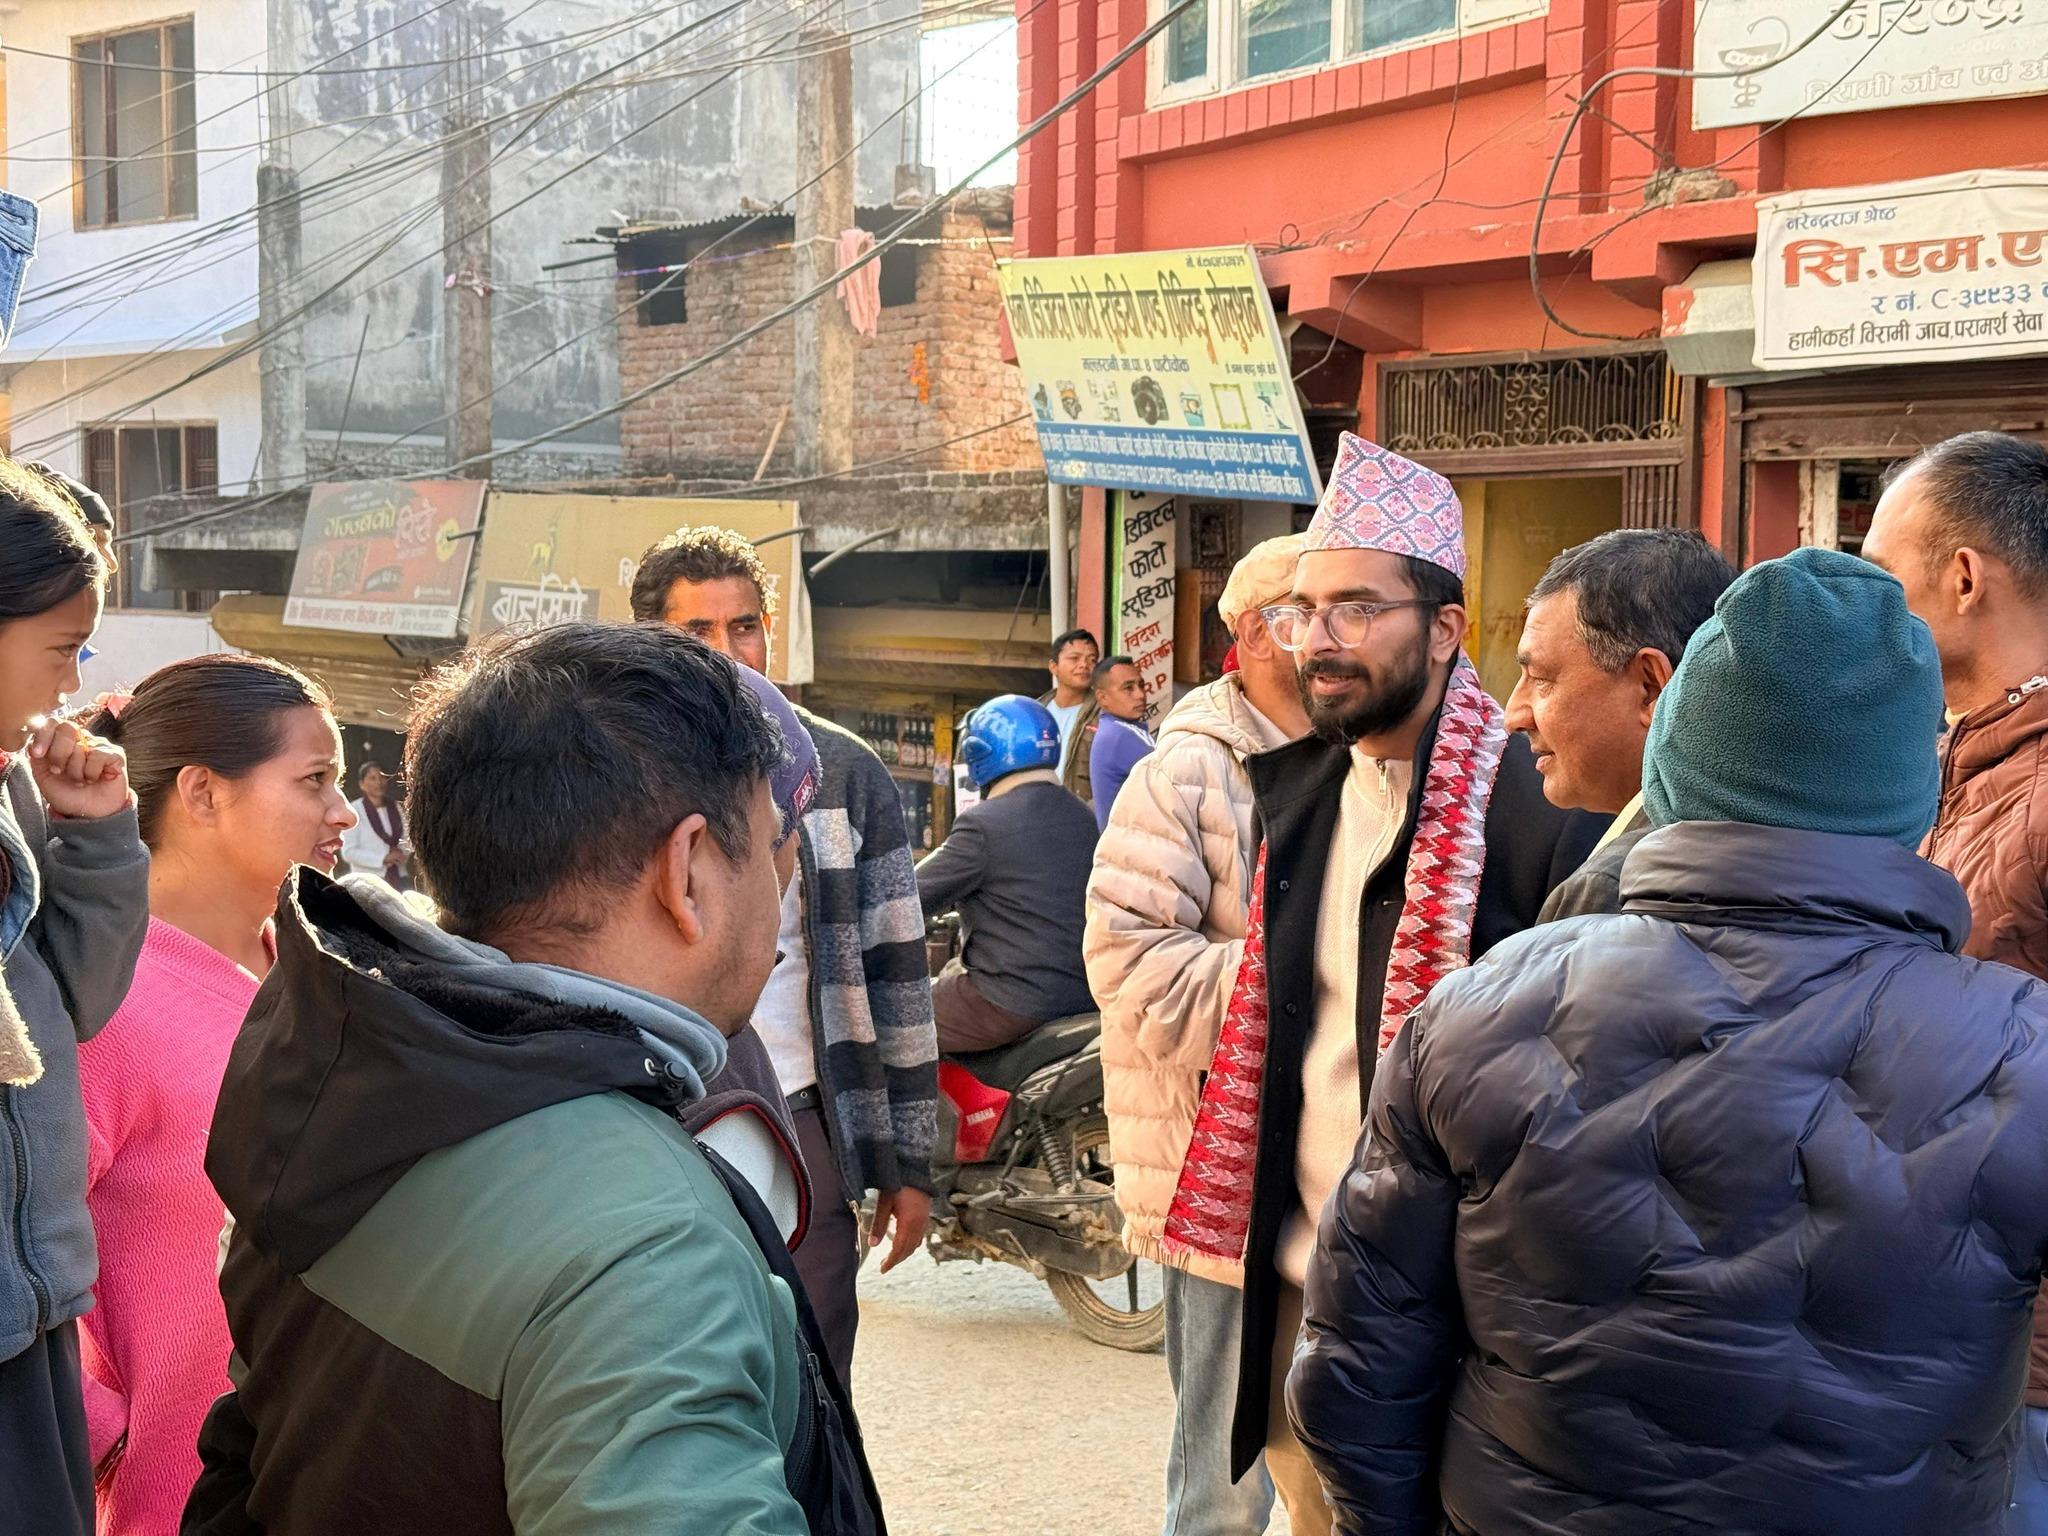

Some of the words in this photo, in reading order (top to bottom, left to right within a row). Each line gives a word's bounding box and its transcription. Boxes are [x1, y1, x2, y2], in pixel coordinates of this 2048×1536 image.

[1067, 274, 1102, 339] फोटो
[2012, 308, 2044, 334] सेवा
[1124, 498, 1176, 545] डिजिटल
[1128, 541, 1167, 578] फोटो
